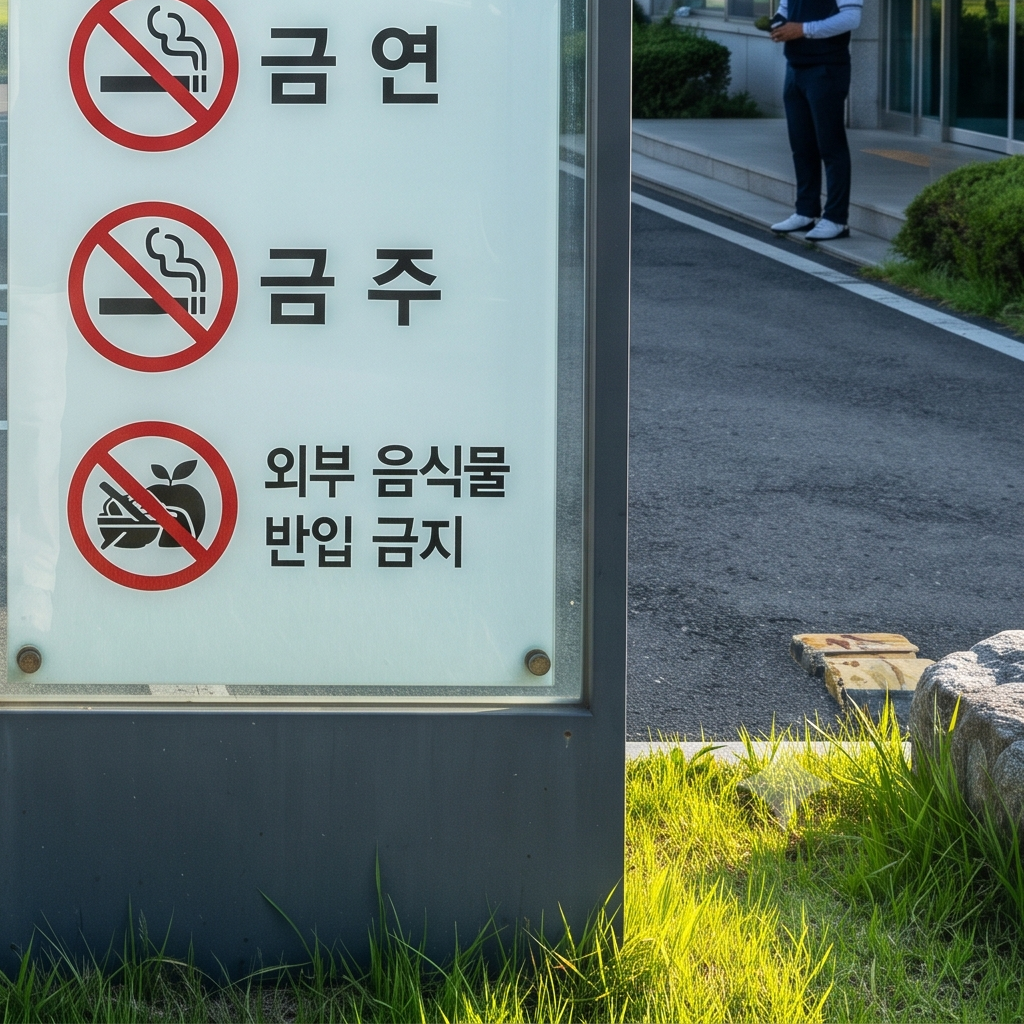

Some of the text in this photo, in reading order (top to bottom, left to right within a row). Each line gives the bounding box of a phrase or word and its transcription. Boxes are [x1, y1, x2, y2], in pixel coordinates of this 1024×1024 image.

[264, 444, 511, 498] 외부 음식물
[265, 514, 462, 569] 반입 금지
